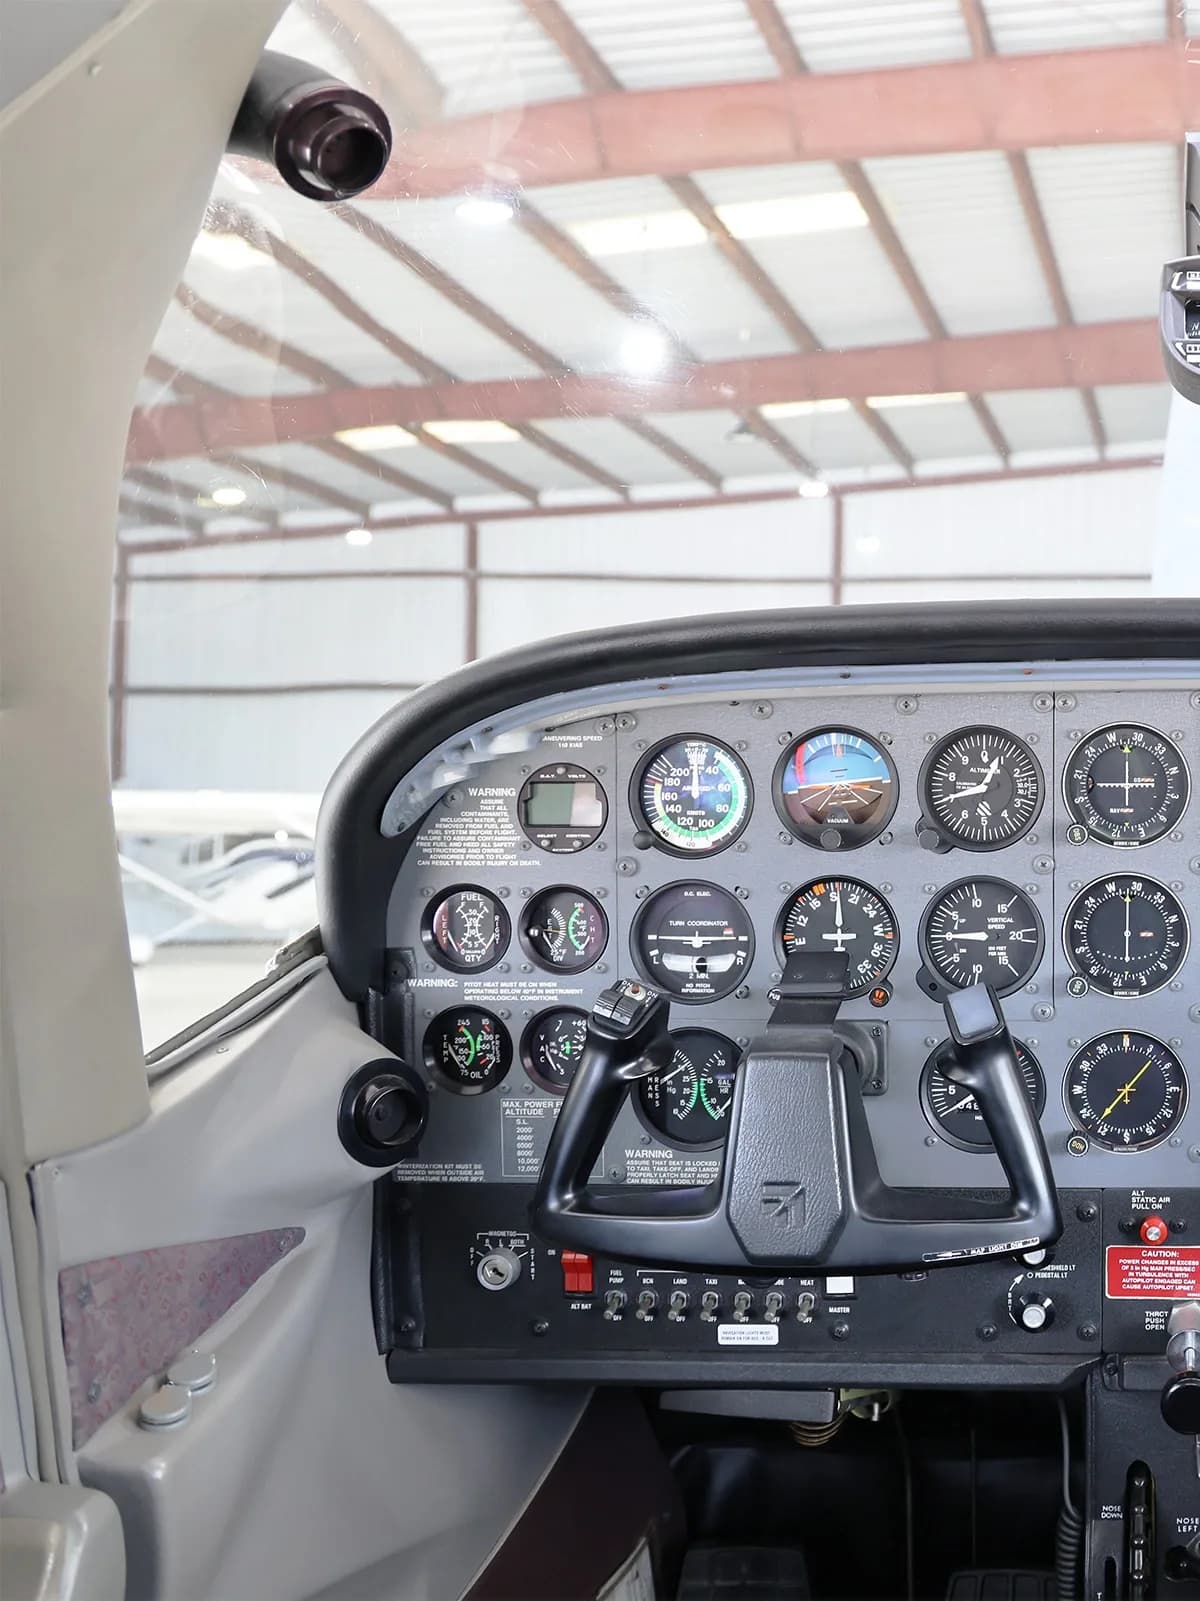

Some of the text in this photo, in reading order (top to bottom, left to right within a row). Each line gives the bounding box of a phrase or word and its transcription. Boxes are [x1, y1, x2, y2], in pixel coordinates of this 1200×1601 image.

[1085, 746, 1097, 757] 24
[1154, 743, 1166, 754] 33
[962, 756, 969, 765] 9
[670, 768, 689, 776] 200
[705, 766, 718, 775] 40
[1014, 769, 1020, 777] 2
[949, 772, 956, 781] 8
[664, 777, 680, 786] 180
[469, 788, 516, 796] WARNING
[718, 783, 730, 792] 60
[662, 792, 678, 800] 160
[1014, 798, 1021, 807] 3
[666, 805, 682, 813] 140
[716, 804, 729, 813] 80
[962, 810, 968, 819] 6
[1001, 809, 1008, 818] 4
[677, 817, 693, 825] 120
[699, 819, 715, 828] 100
[981, 817, 988, 825] 5
[1131, 882, 1142, 891] 30
[848, 894, 860, 903] 21
[1085, 896, 1096, 907] 24
[1154, 892, 1166, 903] 33
[809, 899, 821, 910] 15
[972, 899, 982, 907] 10
[863, 903, 877, 918] 24
[997, 904, 1007, 913] 15
[952, 911, 959, 919] 5
[797, 915, 808, 926] 12
[872, 924, 885, 937] W
[1009, 931, 1022, 940] 20
[796, 937, 806, 945] E
[871, 943, 883, 957] 30
[953, 954, 960, 962] 5
[999, 956, 1008, 964] 15
[858, 959, 872, 973] 33
[973, 965, 982, 973] 10
[407, 979, 458, 987] WARNING:
[949, 1086, 956, 1094] 5
[505, 1108, 543, 1116] ALTITUDE
[625, 1150, 672, 1158] WARNING
[1176, 1517, 1199, 1525] NOSE
[1178, 1525, 1198, 1533] LEFT
